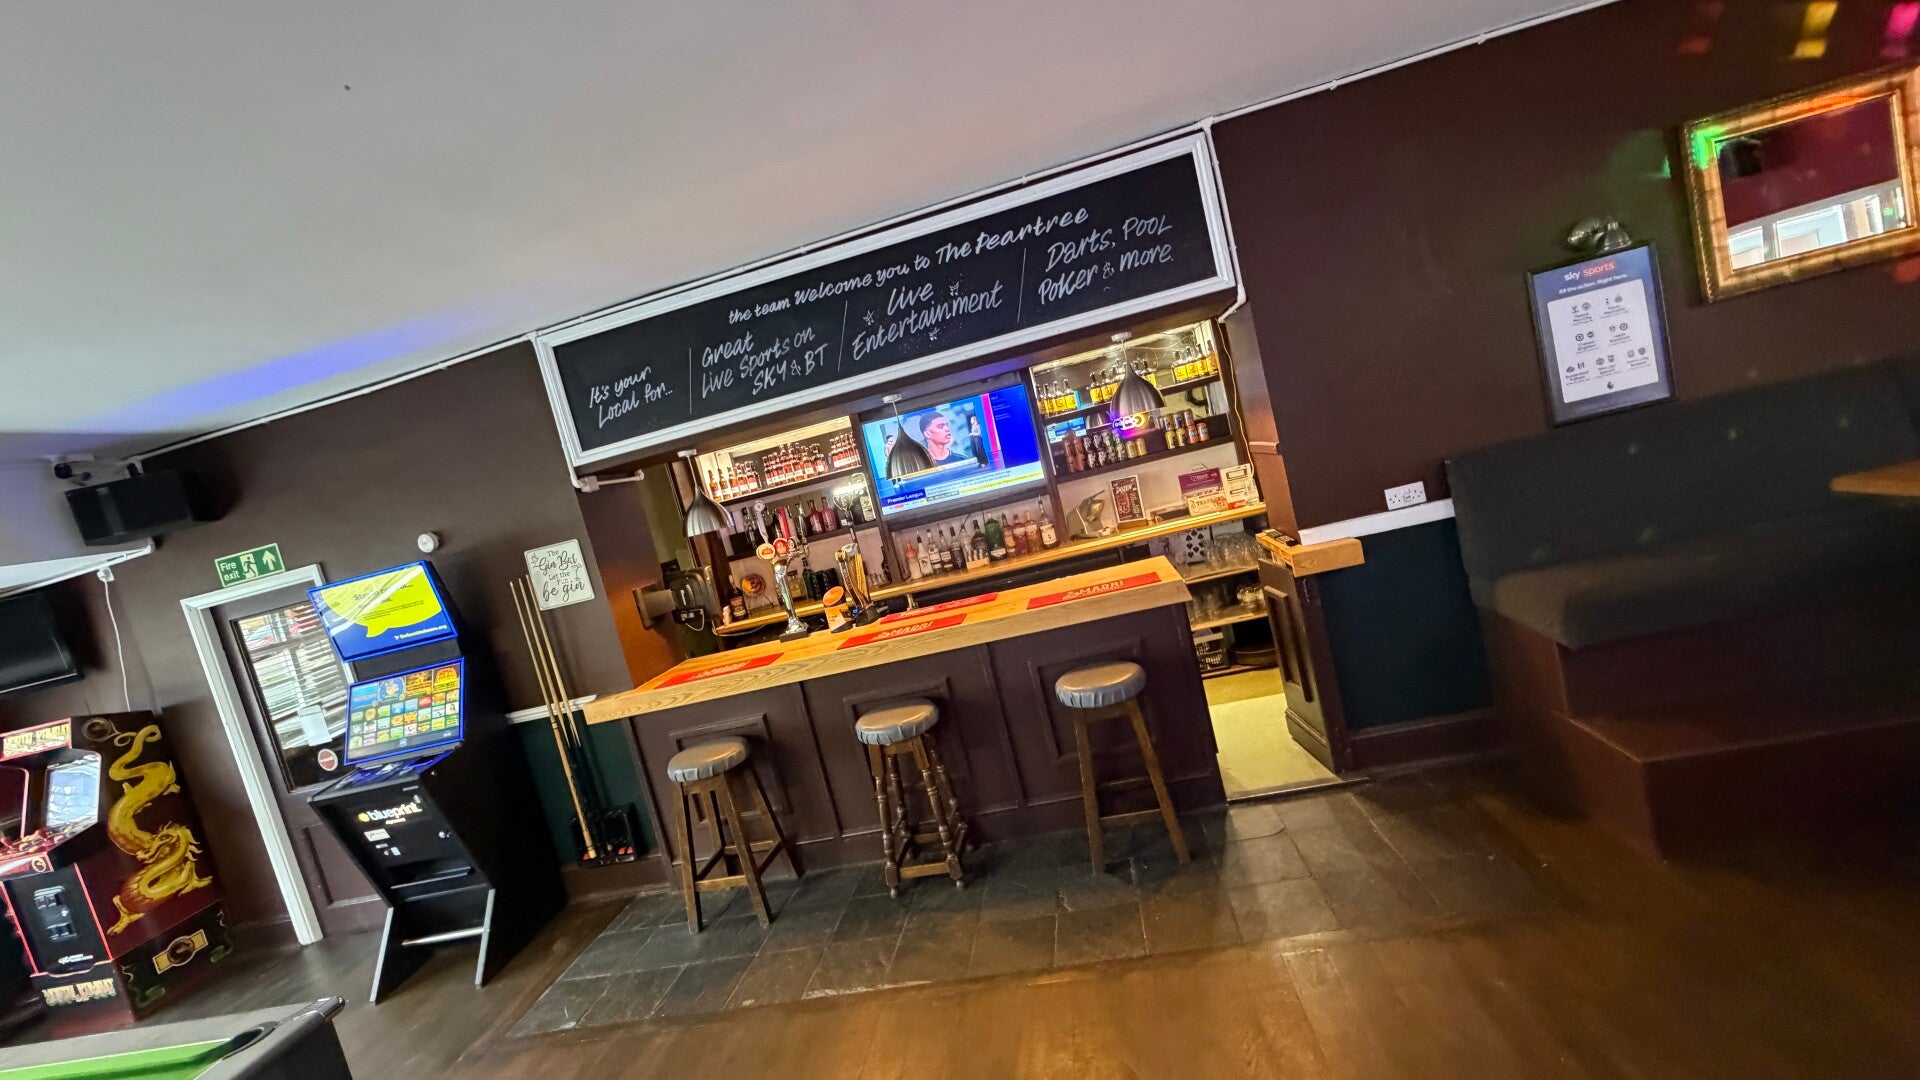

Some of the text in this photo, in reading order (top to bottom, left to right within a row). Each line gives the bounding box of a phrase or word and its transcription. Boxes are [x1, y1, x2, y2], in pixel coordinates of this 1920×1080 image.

[728, 207, 1089, 325] the team Welcome you to The Peartree
[1045, 228, 1116, 273] Darts,
[1102, 261, 1115, 279] &
[1563, 262, 1615, 281] sky sports
[887, 282, 934, 316] Live
[852, 280, 1003, 361] Entertainment
[701, 331, 755, 368] Great
[702, 327, 816, 399] Live Sports on
[791, 360, 801, 376] &
[804, 343, 829, 375] BT
[589, 366, 652, 408] It's your
[598, 390, 640, 429] Local
[220, 562, 237, 572] Fire
[224, 570, 240, 581] exit
[563, 580, 585, 602] gin
